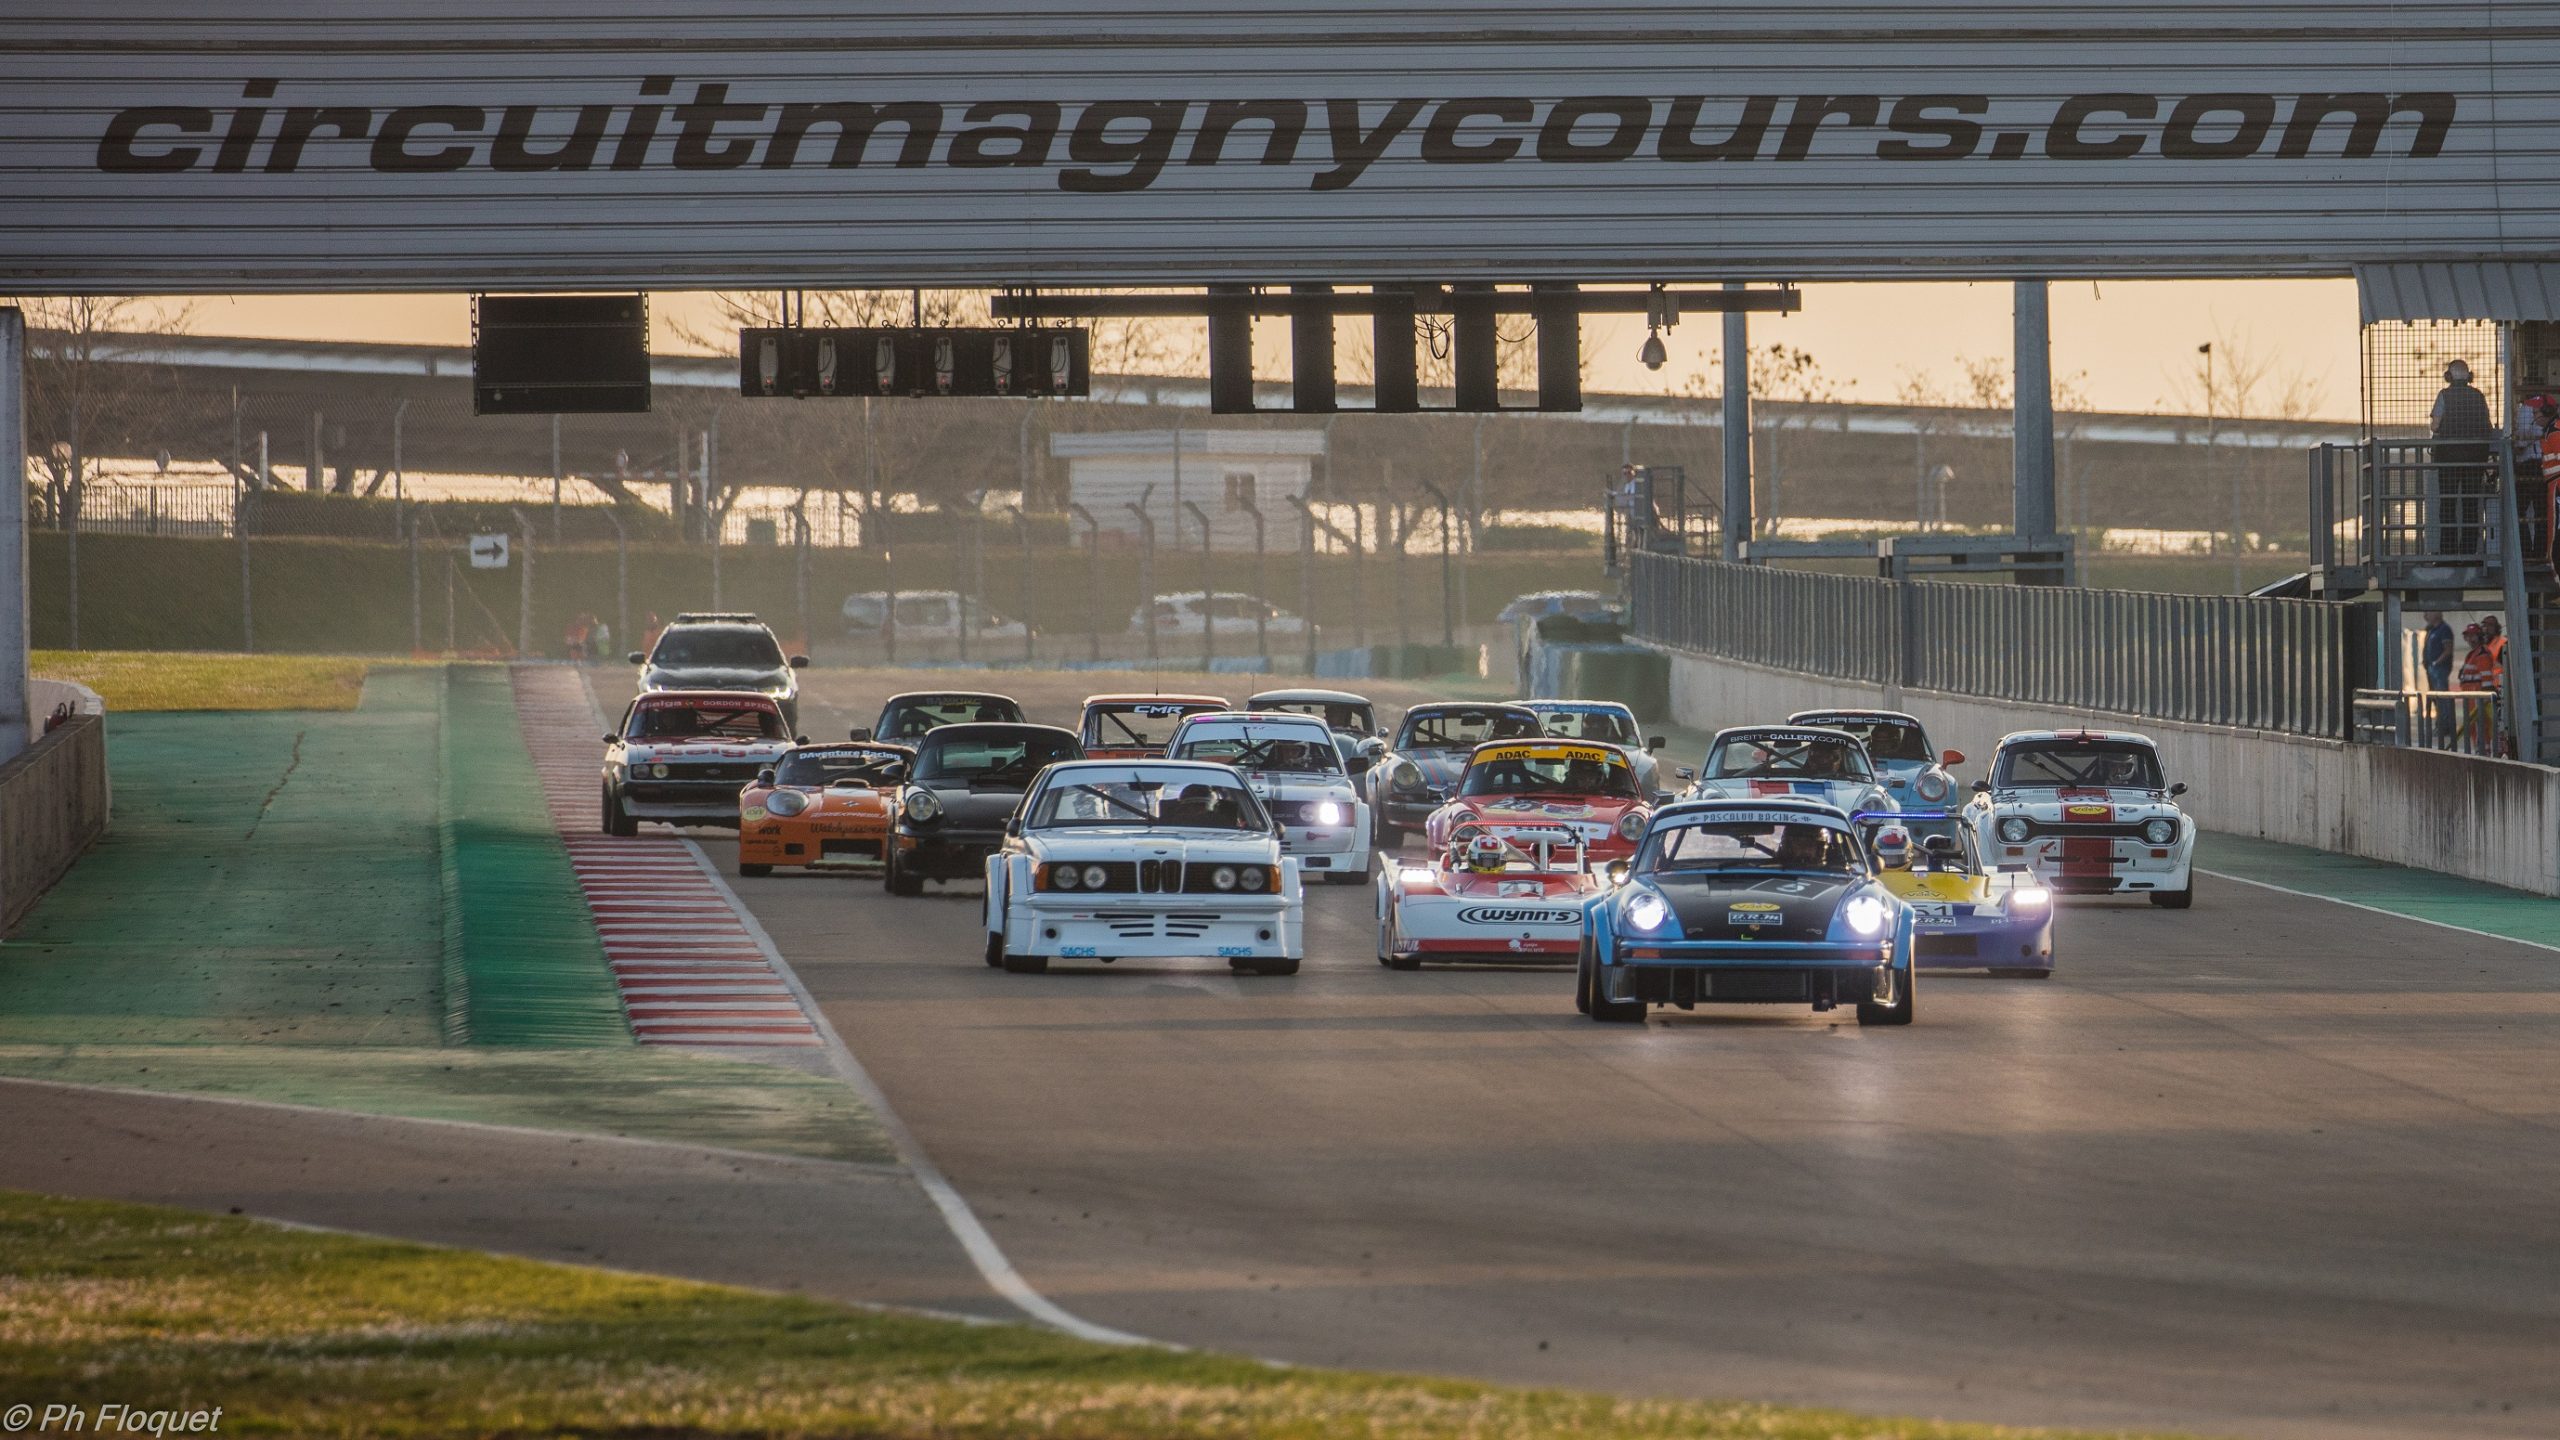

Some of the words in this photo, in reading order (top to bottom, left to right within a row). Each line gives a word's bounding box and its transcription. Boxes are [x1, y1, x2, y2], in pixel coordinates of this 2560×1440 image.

[96, 76, 2456, 192] circuitmagnycours.com
[1133, 706, 1184, 714] CMR
[1801, 717, 1909, 727] PORSCHE
[862, 750, 901, 760] Racing
[1495, 750, 1531, 760] ADAC
[1565, 750, 1601, 761] ADAC
[1758, 812, 1798, 823] RACING
[1060, 946, 1096, 957] SACHS
[1217, 946, 1252, 957] SACHS
